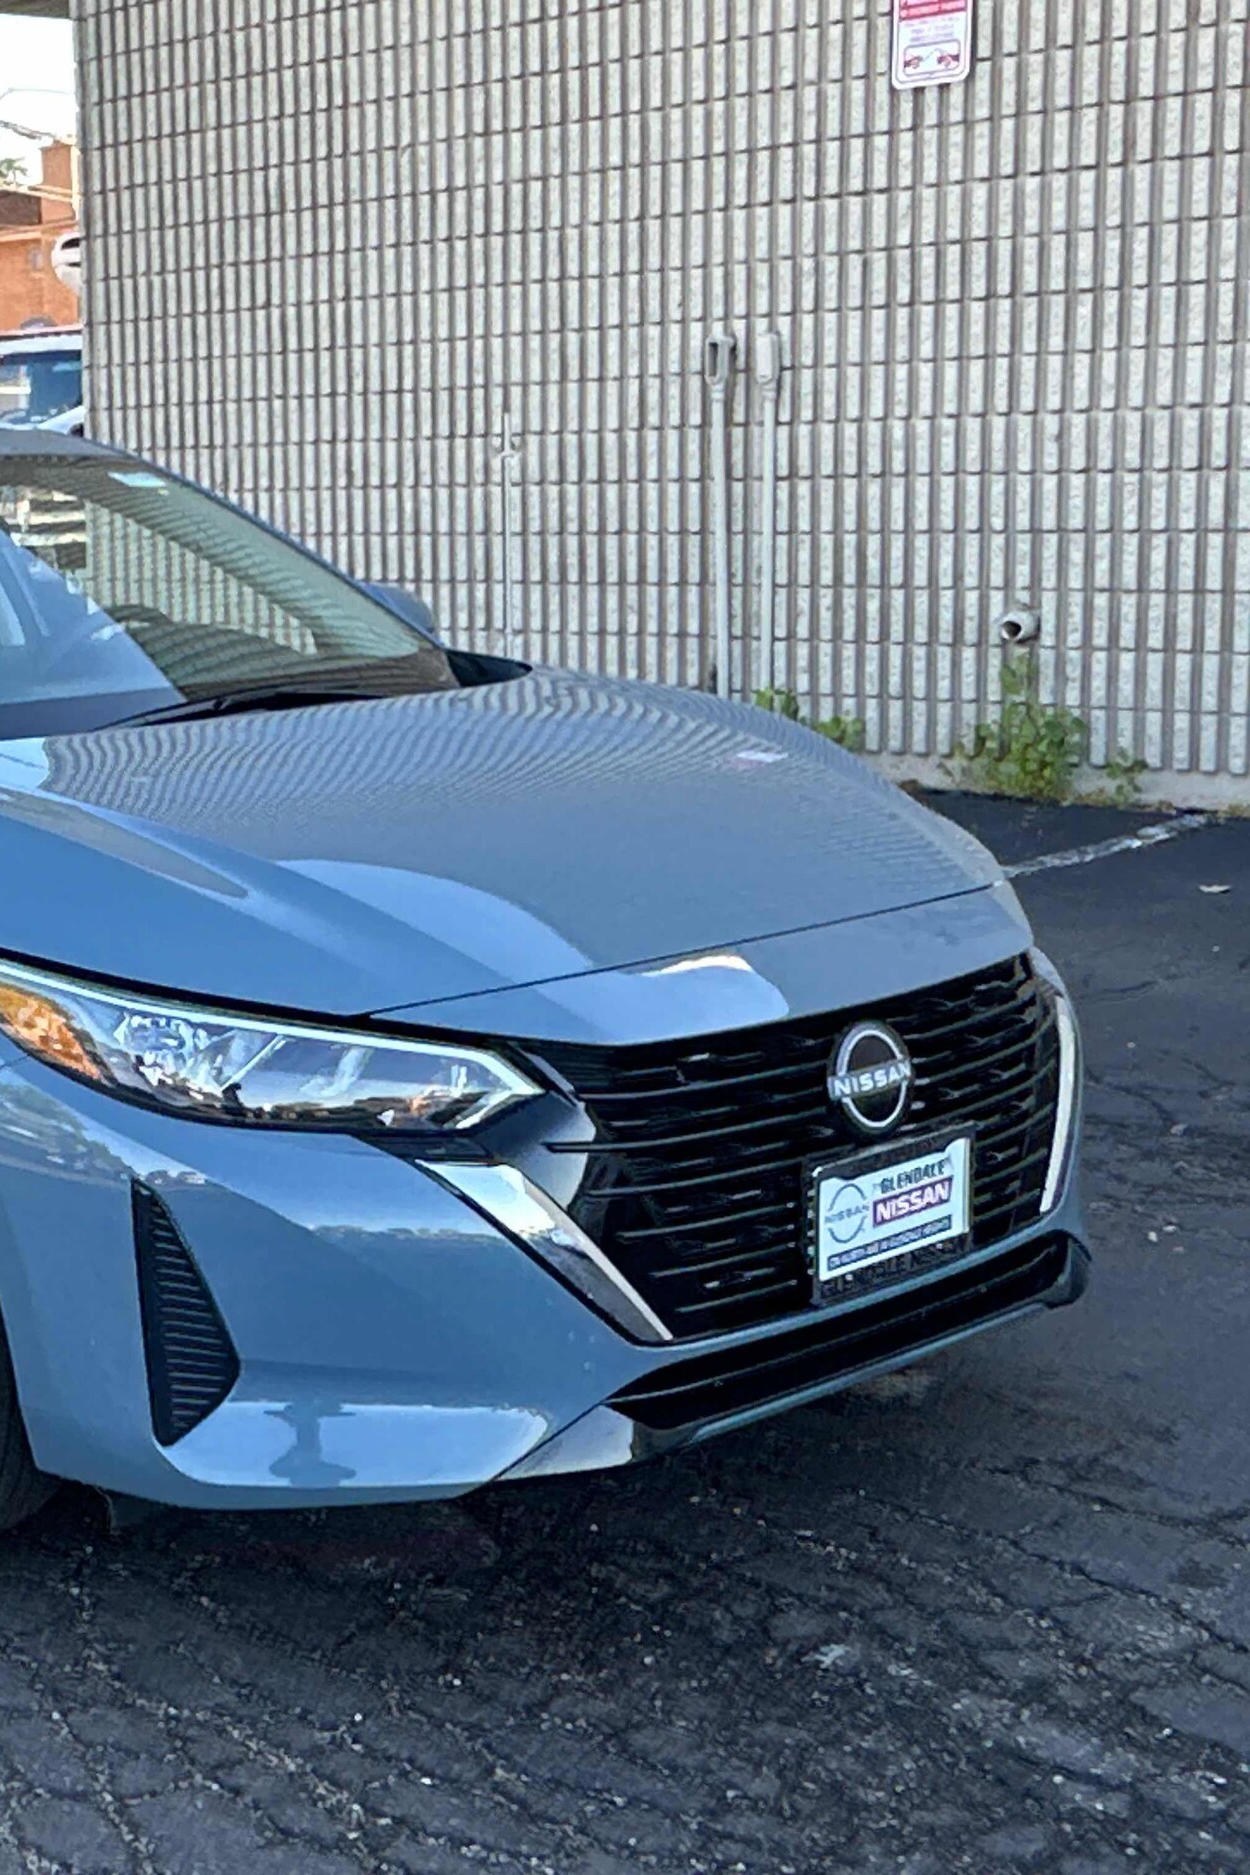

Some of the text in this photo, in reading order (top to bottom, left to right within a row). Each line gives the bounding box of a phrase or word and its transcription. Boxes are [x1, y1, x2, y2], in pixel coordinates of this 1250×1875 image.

[834, 1060, 912, 1097] NISSAN
[881, 1159, 946, 1194] GLENDALE
[876, 1181, 950, 1224] NISSAN
